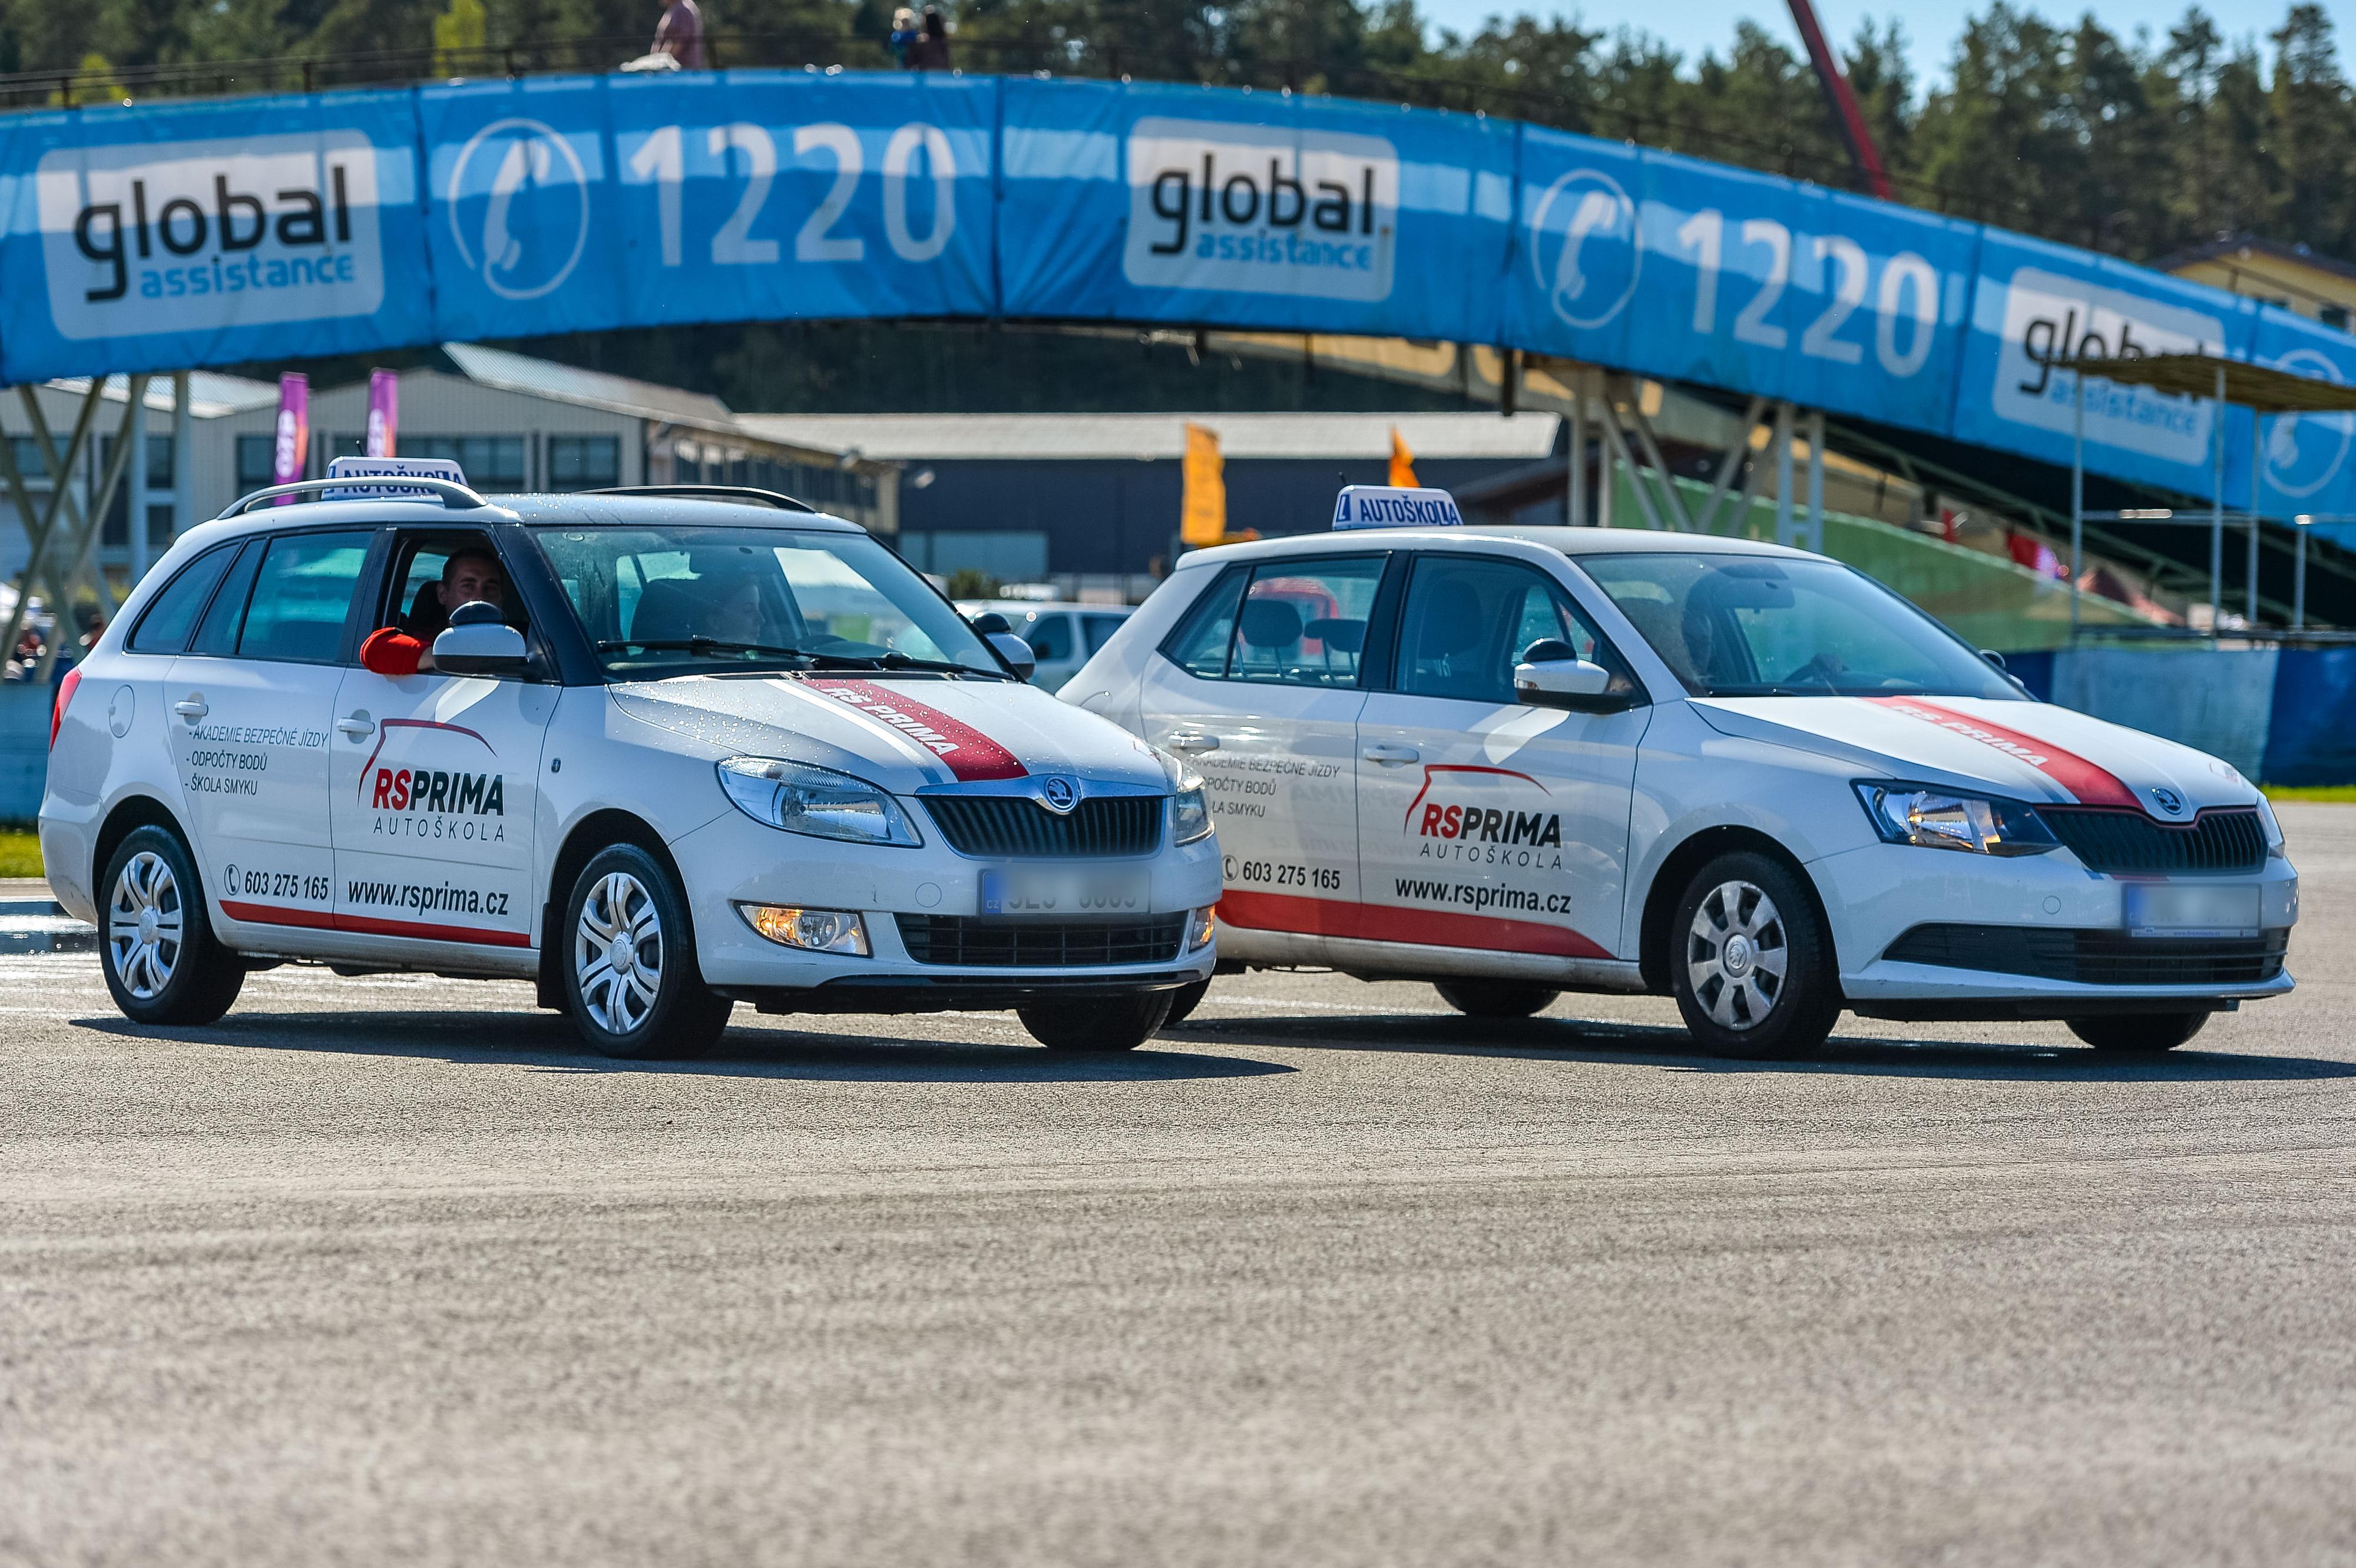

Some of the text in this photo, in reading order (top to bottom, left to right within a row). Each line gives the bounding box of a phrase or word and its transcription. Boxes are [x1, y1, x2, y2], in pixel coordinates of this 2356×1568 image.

[630, 123, 957, 266] 1220
[1150, 153, 1376, 255] global
[74, 166, 352, 303] global
[1196, 228, 1372, 272] assistance
[141, 253, 355, 299] assistance
[1678, 208, 1939, 378] 1220
[2019, 310, 2205, 393] glob
[344, 465, 461, 494] AUTOŠKO
[1360, 494, 1459, 525] AUTOŠKOLA
[193, 726, 243, 742] AKADEMIE
[243, 727, 298, 746] BEZPEČNÉ
[298, 729, 329, 748] JÍZDY
[820, 688, 960, 755] RS PRIMA
[191, 750, 238, 768] ODPOČTY
[1940, 721, 2049, 766] PRIMA
[190, 773, 221, 793] ŠKOLA
[224, 778, 258, 795] SMYKU
[372, 768, 504, 816] RSPRIMA
[1203, 776, 1244, 792] POČTY
[1227, 801, 1266, 818] SMYKU
[1420, 803, 1561, 848] RSPRIMA
[373, 815, 504, 842] AUTOŠKOLA
[1420, 843, 1562, 870] AUTOŠKOLA
[245, 871, 329, 900] 603 275 165
[1243, 861, 1341, 889] 603 275 165
[349, 881, 509, 916] www.rsprima.cz
[987, 899, 1000, 909] CZ
[1395, 878, 1571, 914] www.rsprima.cz
